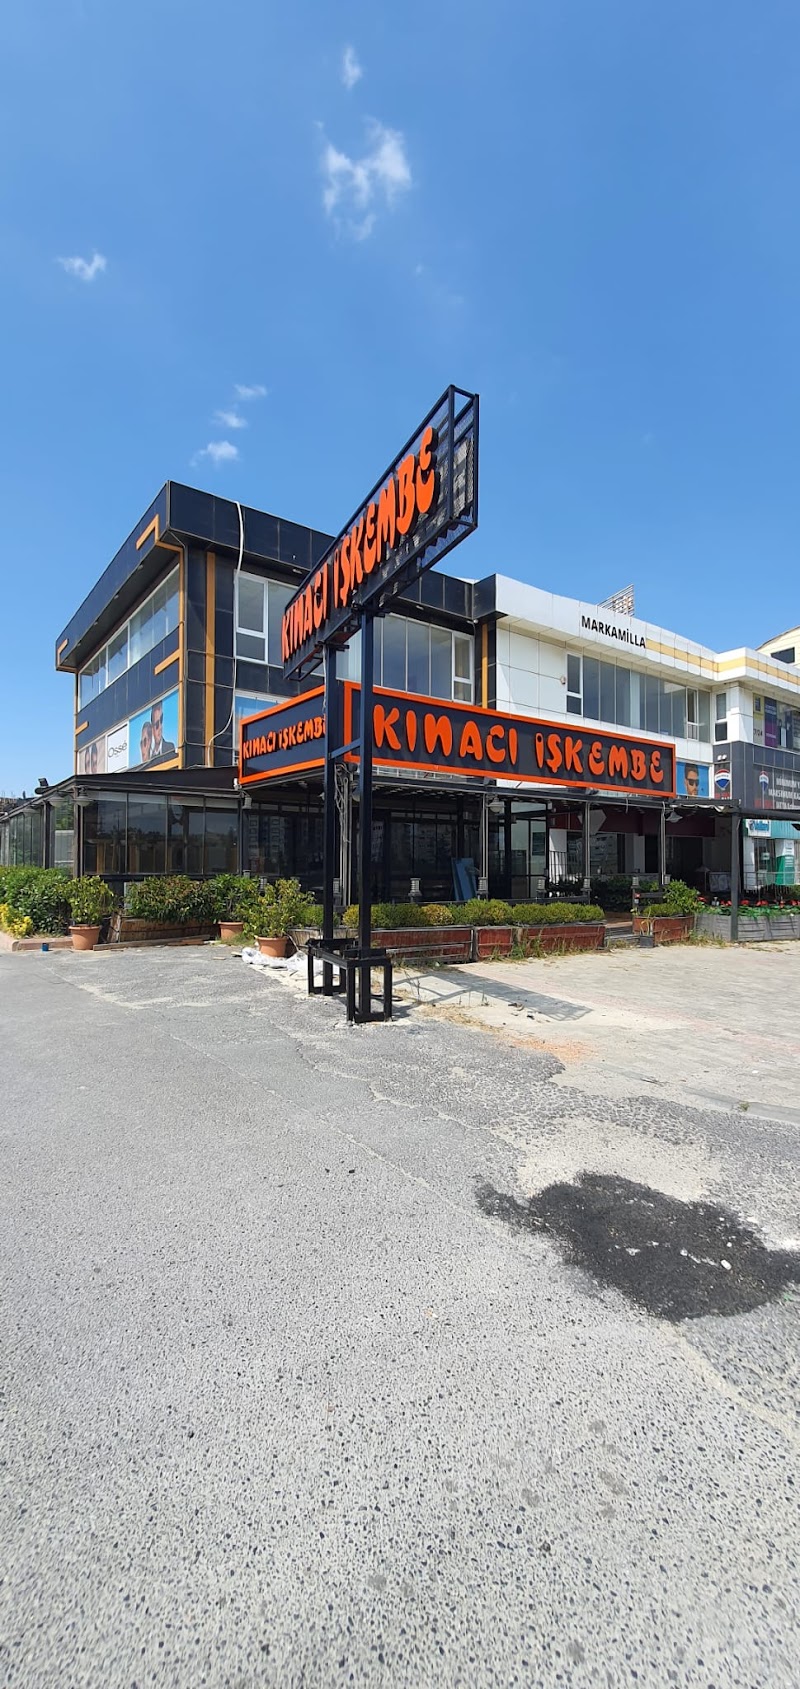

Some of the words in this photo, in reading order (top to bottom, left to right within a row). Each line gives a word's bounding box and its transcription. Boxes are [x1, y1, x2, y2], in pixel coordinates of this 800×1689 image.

[280, 563, 328, 662] KINACI
[333, 426, 435, 608] İŞKEMBE
[581, 615, 646, 649] MARKAMİLLA
[242, 731, 276, 760] KINACI
[373, 704, 517, 765] KINACI
[535, 733, 664, 784] İŞKEMBE
